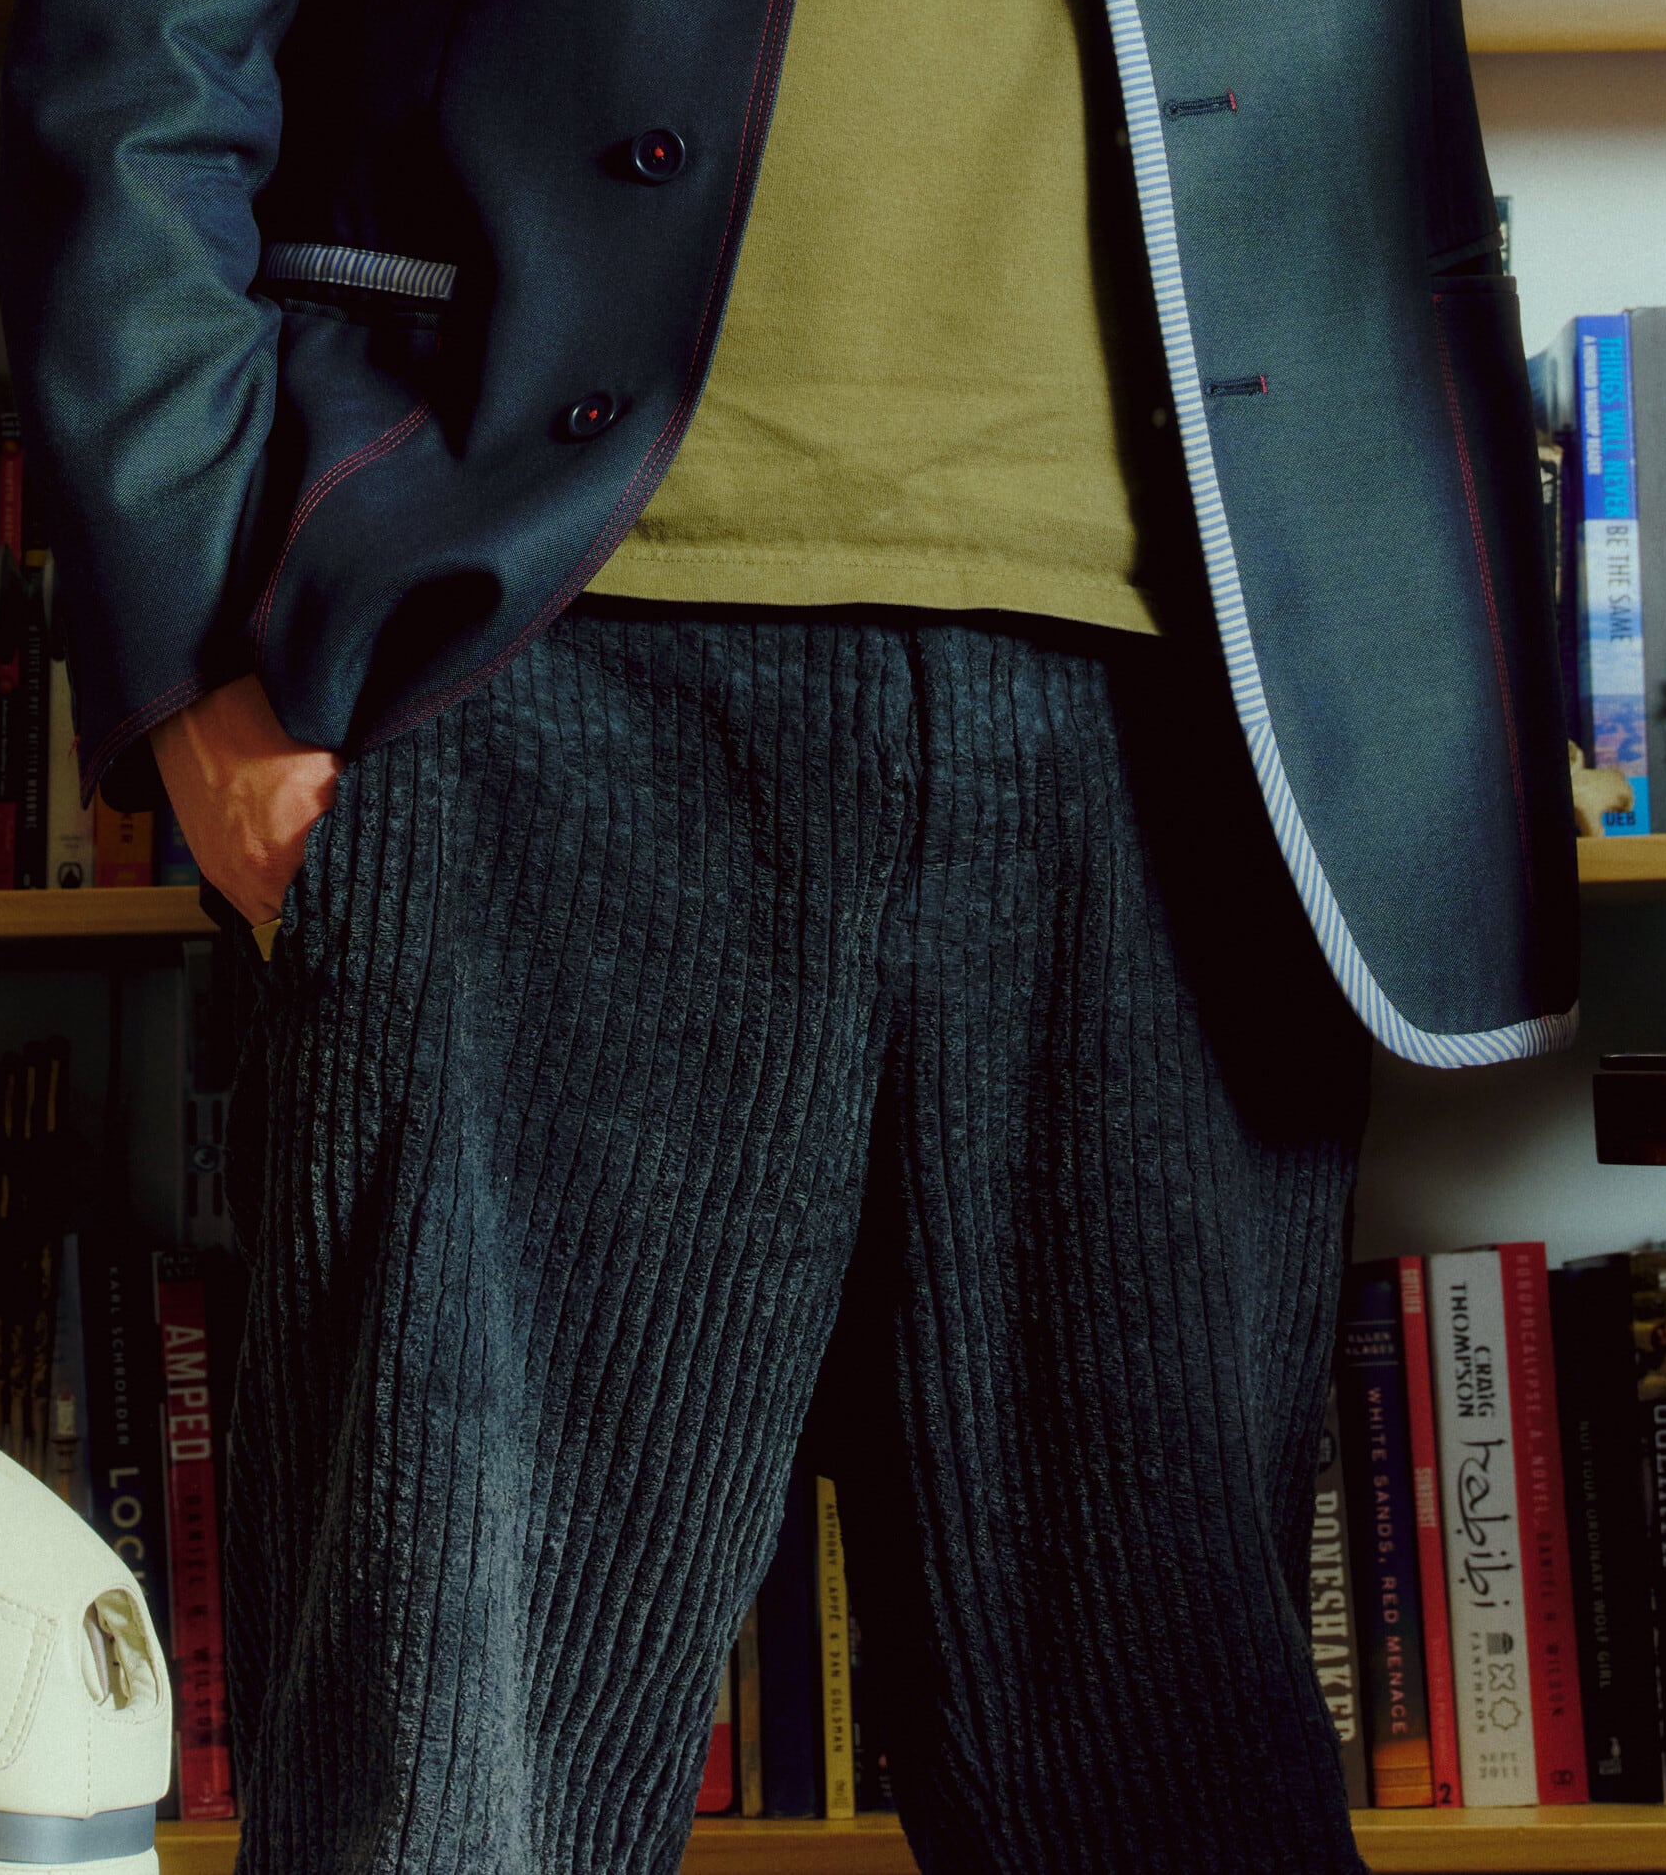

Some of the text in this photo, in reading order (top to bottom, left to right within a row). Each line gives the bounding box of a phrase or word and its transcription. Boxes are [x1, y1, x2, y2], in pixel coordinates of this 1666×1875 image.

[1598, 335, 1634, 642] THINGS WILL NEVER BE THE SAME
[111, 1326, 130, 1446] SCHROEDER
[164, 1323, 213, 1463] AMPED
[1449, 1280, 1475, 1418] THOMPSON
[1473, 1344, 1497, 1418] CRAIG
[1367, 1386, 1408, 1735] WHITE SANDS, RED MENACE
[1455, 1436, 1516, 1610] habibi
[1584, 1508, 1606, 1593] ORDINARY
[830, 1650, 842, 1678] DAN
[1591, 1599, 1610, 1647] WOLF
[1595, 1650, 1614, 1690] GIRL
[832, 1688, 845, 1753] GOLDMAN
